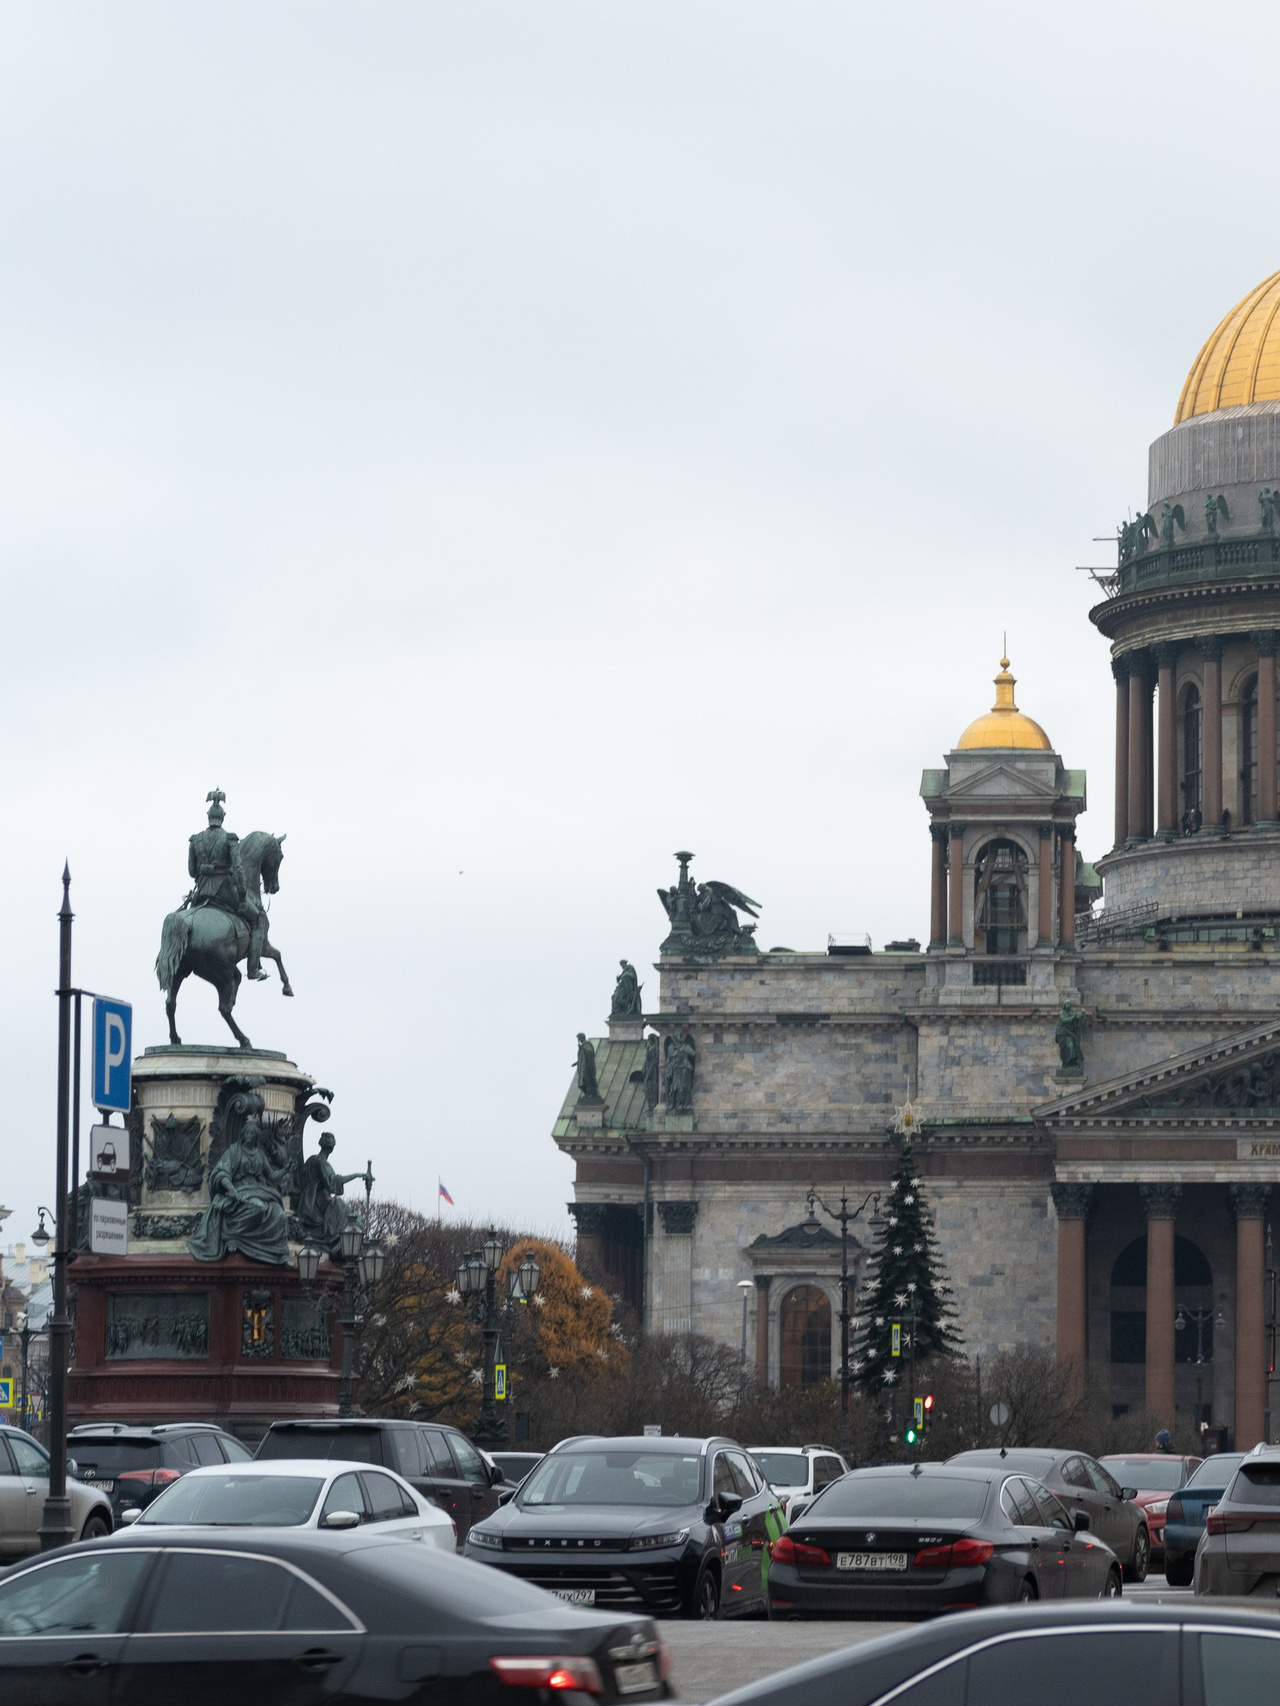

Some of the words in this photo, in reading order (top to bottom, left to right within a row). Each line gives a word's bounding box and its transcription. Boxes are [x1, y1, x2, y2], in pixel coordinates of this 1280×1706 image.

[104, 1012, 126, 1095] P
[887, 1553, 905, 1564] 198
[574, 1590, 593, 1601] 797
